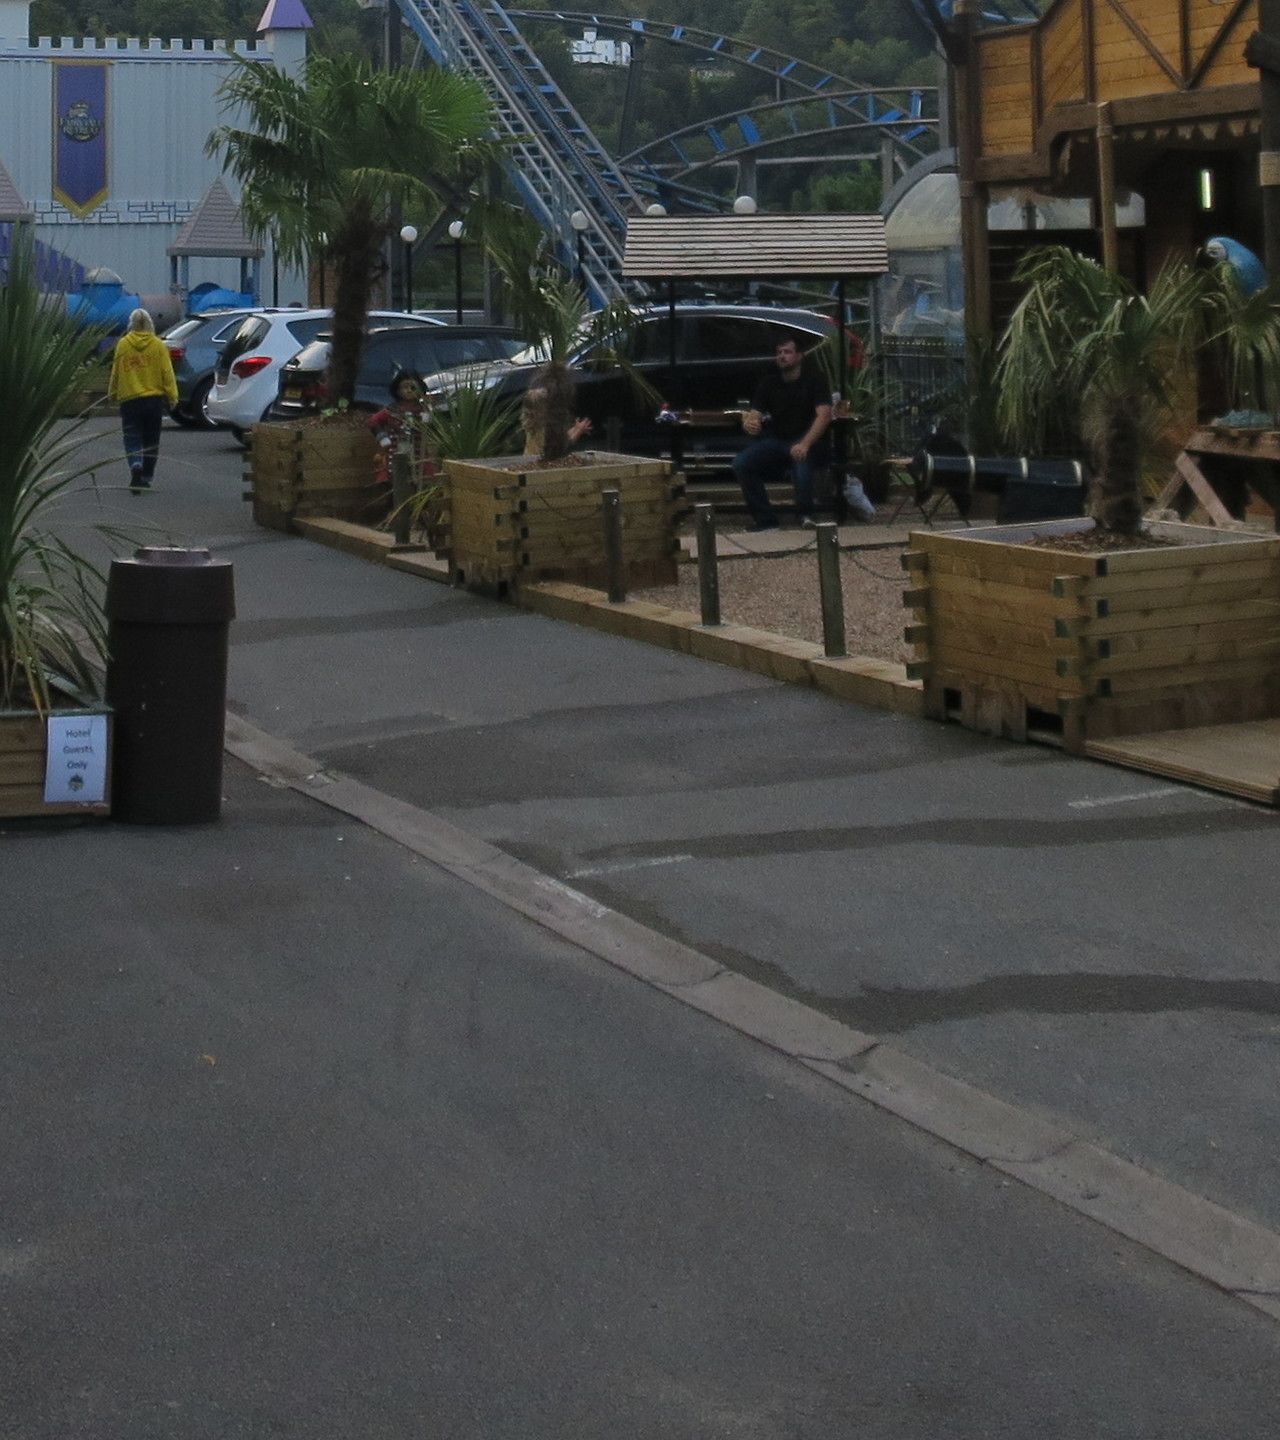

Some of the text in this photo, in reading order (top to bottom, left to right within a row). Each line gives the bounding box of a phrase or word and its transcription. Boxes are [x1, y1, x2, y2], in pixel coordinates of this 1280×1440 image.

[65, 728, 91, 737] Hotel
[63, 745, 93, 754] Guests
[67, 761, 87, 769] Only
